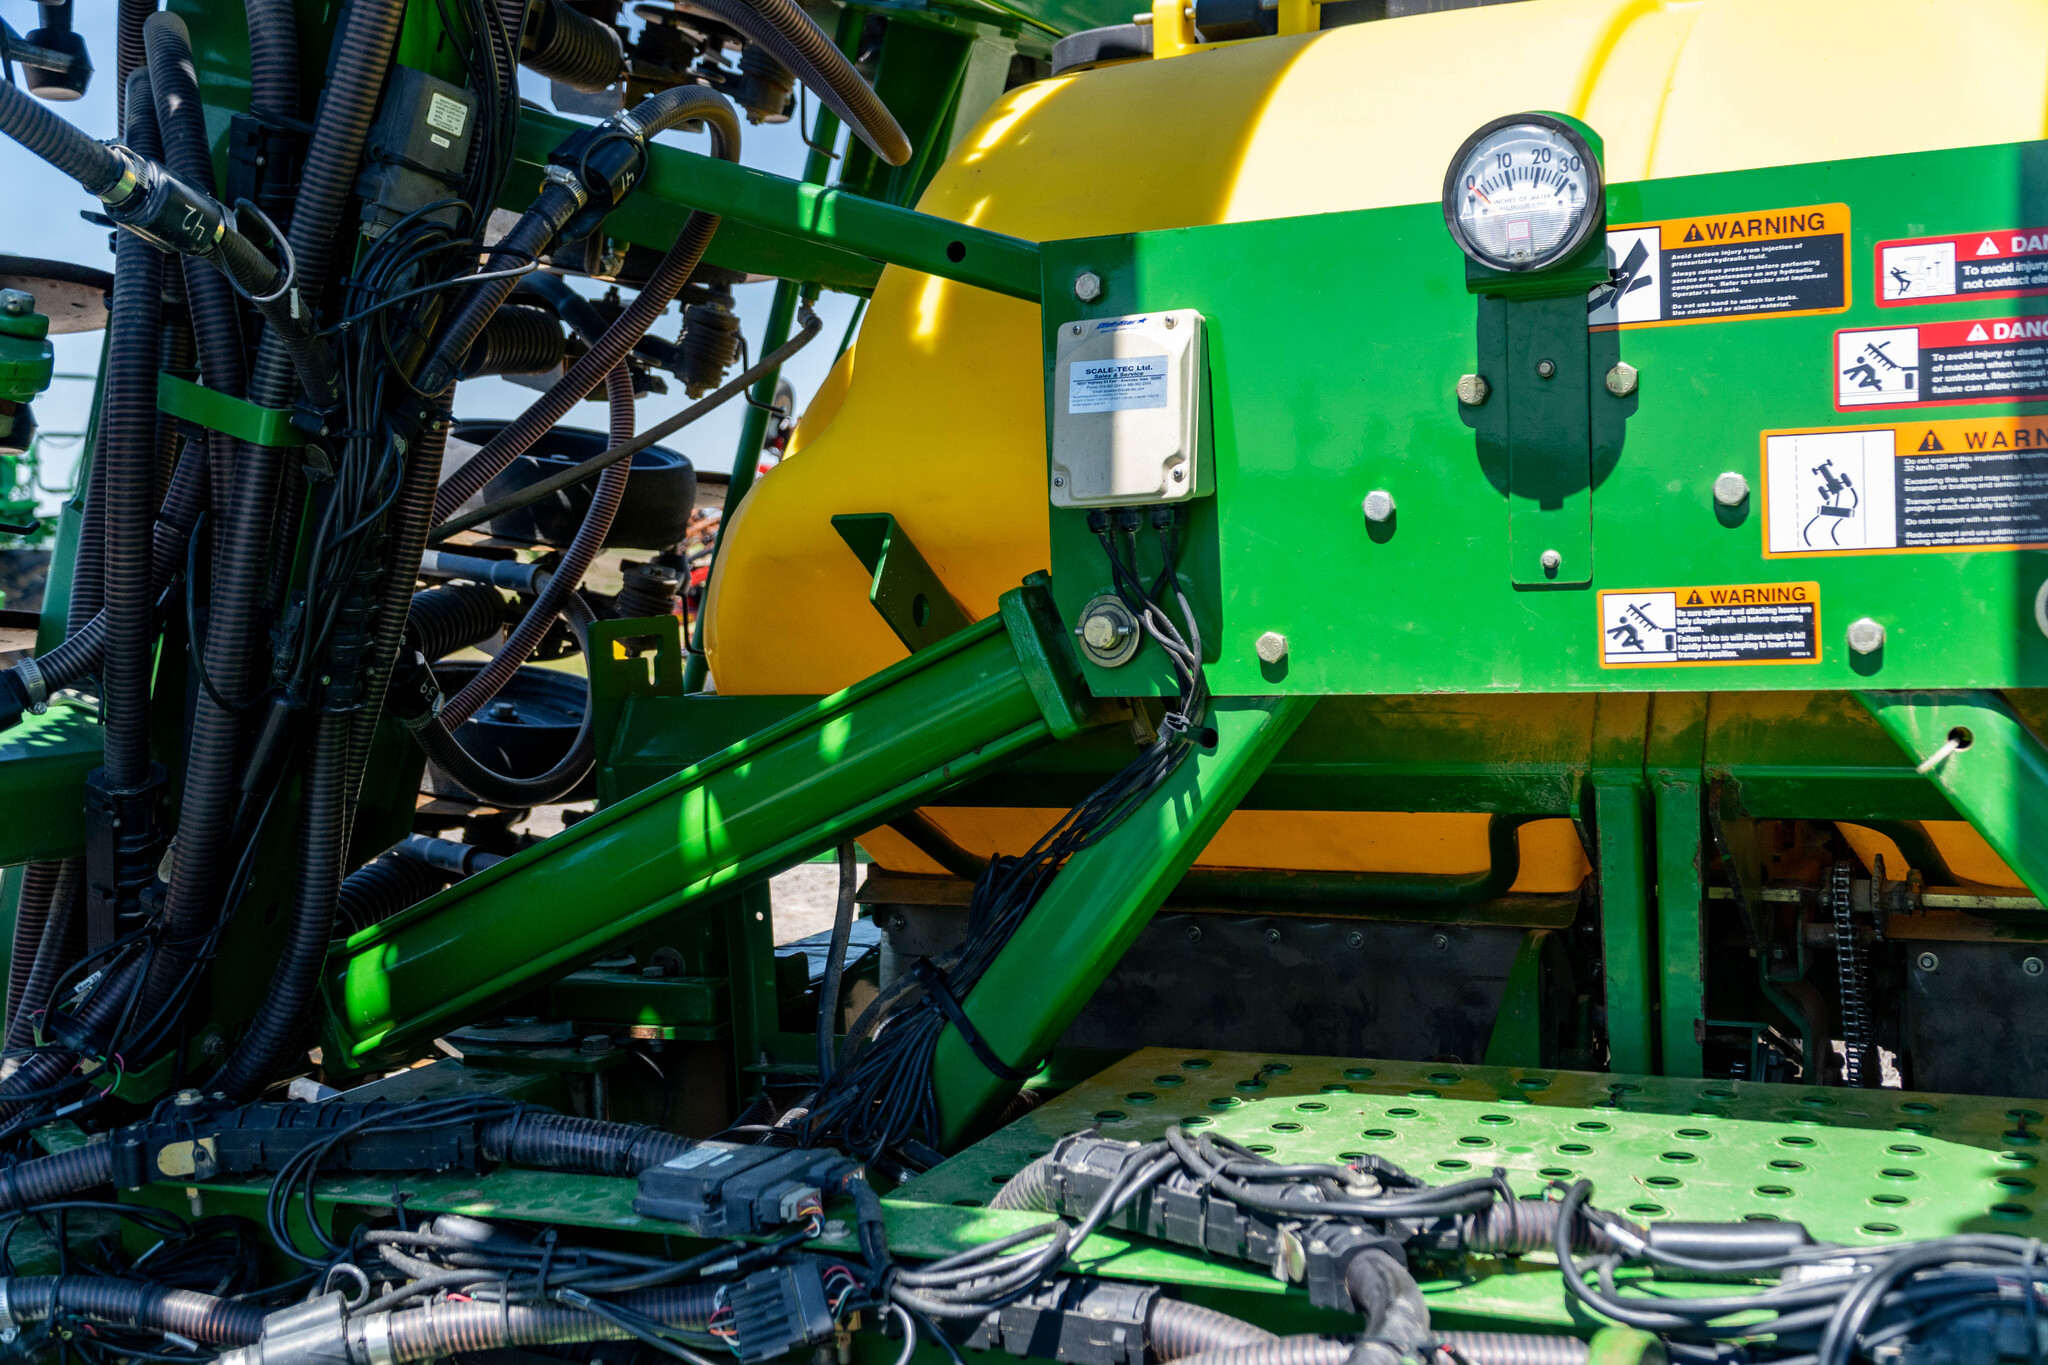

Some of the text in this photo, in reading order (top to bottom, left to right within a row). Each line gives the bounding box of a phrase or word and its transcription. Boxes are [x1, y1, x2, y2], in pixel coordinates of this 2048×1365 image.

[1496, 152, 1512, 169] 10
[1531, 147, 1551, 165] 20
[1560, 155, 1580, 173] 30
[621, 172, 635, 191] 41
[1466, 175, 1476, 190] 0
[182, 204, 205, 240] 42
[1706, 212, 1824, 240] WARNING
[1762, 244, 1793, 253] injection
[1672, 258, 1712, 267] pressurized
[1714, 255, 1746, 264] hydraulic
[1672, 270, 1696, 278] Always
[1781, 260, 1820, 269] performing
[1709, 272, 1752, 280] maintenance
[1780, 267, 1813, 276] hydraulic
[1962, 264, 1979, 276] To
[1980, 261, 2014, 274] avoid
[1672, 282, 1716, 292] components.
[1791, 273, 1828, 282] implement
[1963, 274, 2030, 290] not contact
[1672, 289, 1709, 298] Operator's
[1931, 353, 1945, 362] To
[1946, 351, 1973, 361] avoid
[1974, 349, 2003, 360] injury
[1086, 366, 1134, 374] SCALE-TEC
[1932, 364, 1943, 372] of
[1944, 362, 1985, 372] machine
[1986, 360, 2013, 369] when
[2014, 358, 2043, 369] wings
[1944, 372, 1990, 382] unfolded.
[1991, 368, 2045, 379] Mechanical
[1932, 385, 1963, 394] failure
[2011, 379, 2040, 390] wings
[1965, 428, 2048, 449] WARN
[1710, 587, 1806, 603] WARNING
[1677, 610, 1686, 618] Be
[1703, 608, 1730, 618] cylinder
[1731, 607, 1745, 616] and
[1746, 606, 1777, 616] attaching
[1778, 605, 1799, 614] hoses
[1677, 618, 1692, 627] fully
[1692, 617, 1720, 626] charged
[1770, 614, 1803, 623] operating
[1677, 626, 1704, 634] system.
[1764, 632, 1785, 642] wings
[1678, 644, 1701, 652] rapidly
[1722, 641, 1758, 651] attempting
[1678, 650, 1739, 660] transport position.
